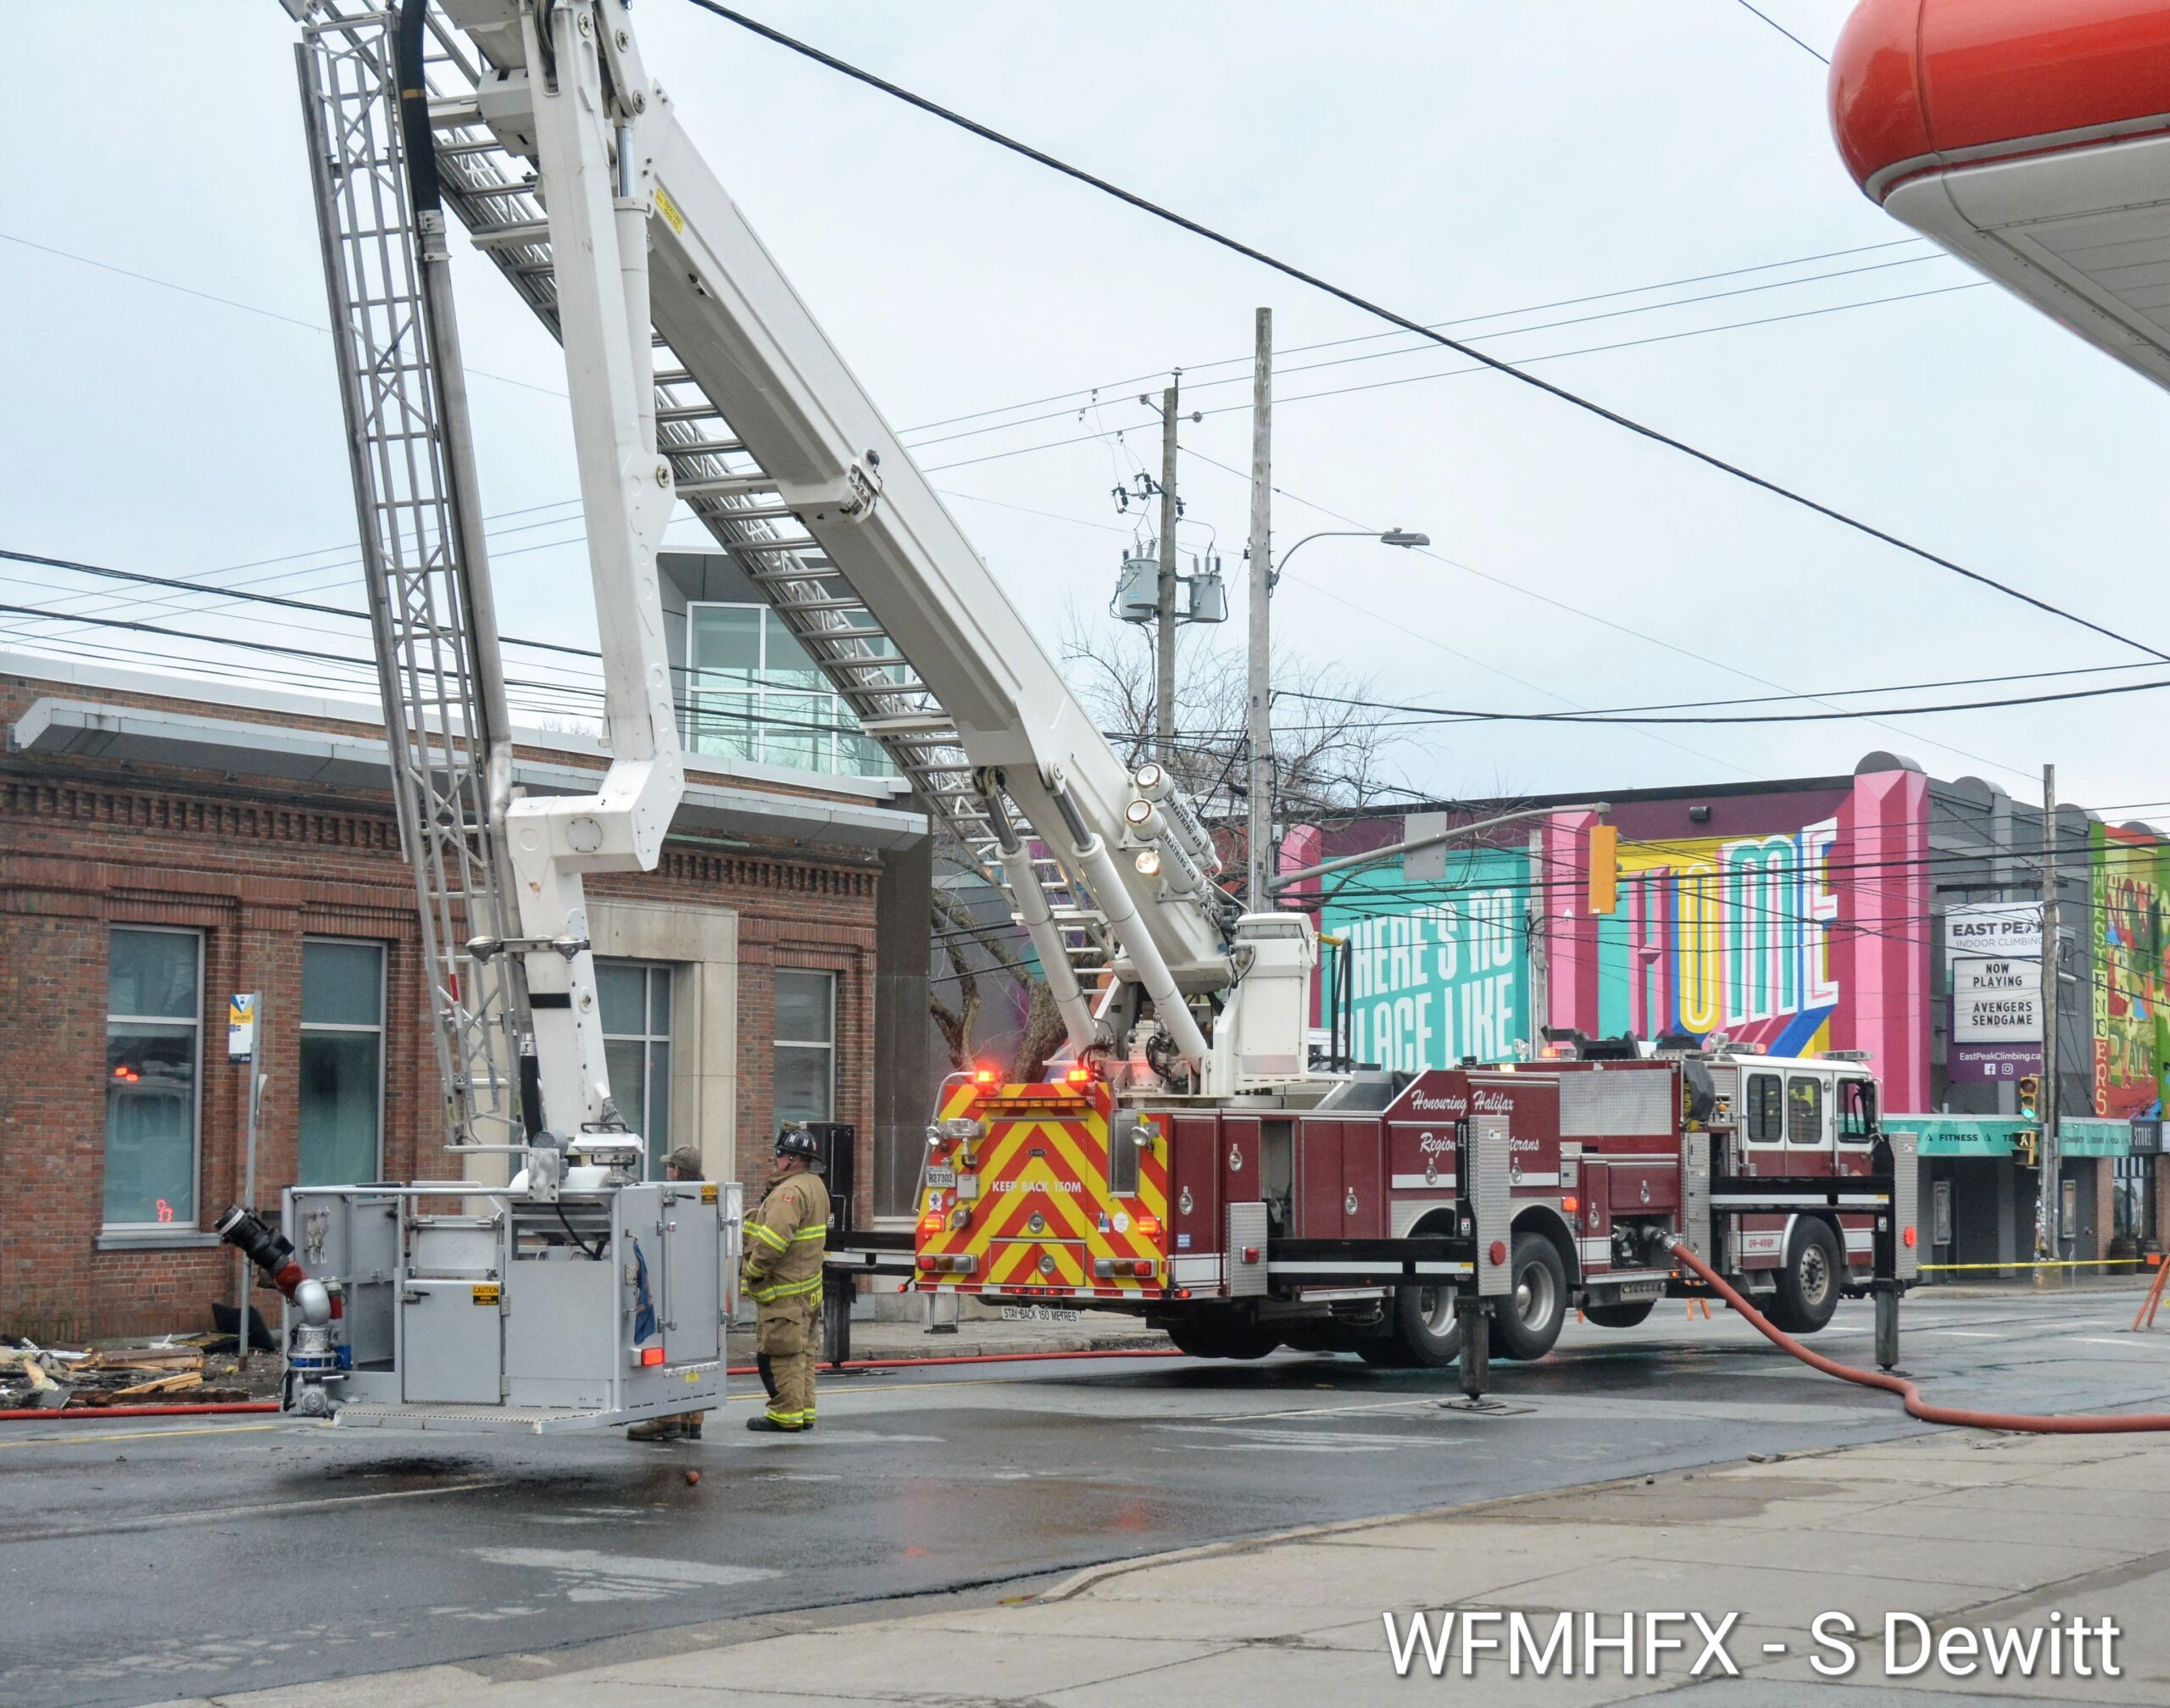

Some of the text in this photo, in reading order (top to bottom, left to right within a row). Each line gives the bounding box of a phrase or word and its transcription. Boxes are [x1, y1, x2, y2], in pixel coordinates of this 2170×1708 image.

[1628, 817, 1839, 1039] HOME
[1953, 922, 1997, 937] EAST
[1332, 888, 1513, 1004] THERE'S NO
[1956, 938, 1995, 948] INDOOR
[1986, 963, 2010, 974] NOW
[1973, 976, 2023, 987] PLAYING
[1973, 1001, 2033, 1013] AVENGERS
[1444, 972, 1514, 1069] LIKE
[1972, 1014, 2033, 1026] SENDGAME
[1959, 1052, 2041, 1061] EastPeakClimbing.ca
[1410, 1089, 1514, 1116] Honouring Halifax
[1939, 1133, 1978, 1142] FITNESS
[1420, 1132, 1539, 1158] Region terans
[992, 1181, 1082, 1193] KEEP BACK 150M
[1004, 1307, 1077, 1322] STAY BACK 150 METRES
